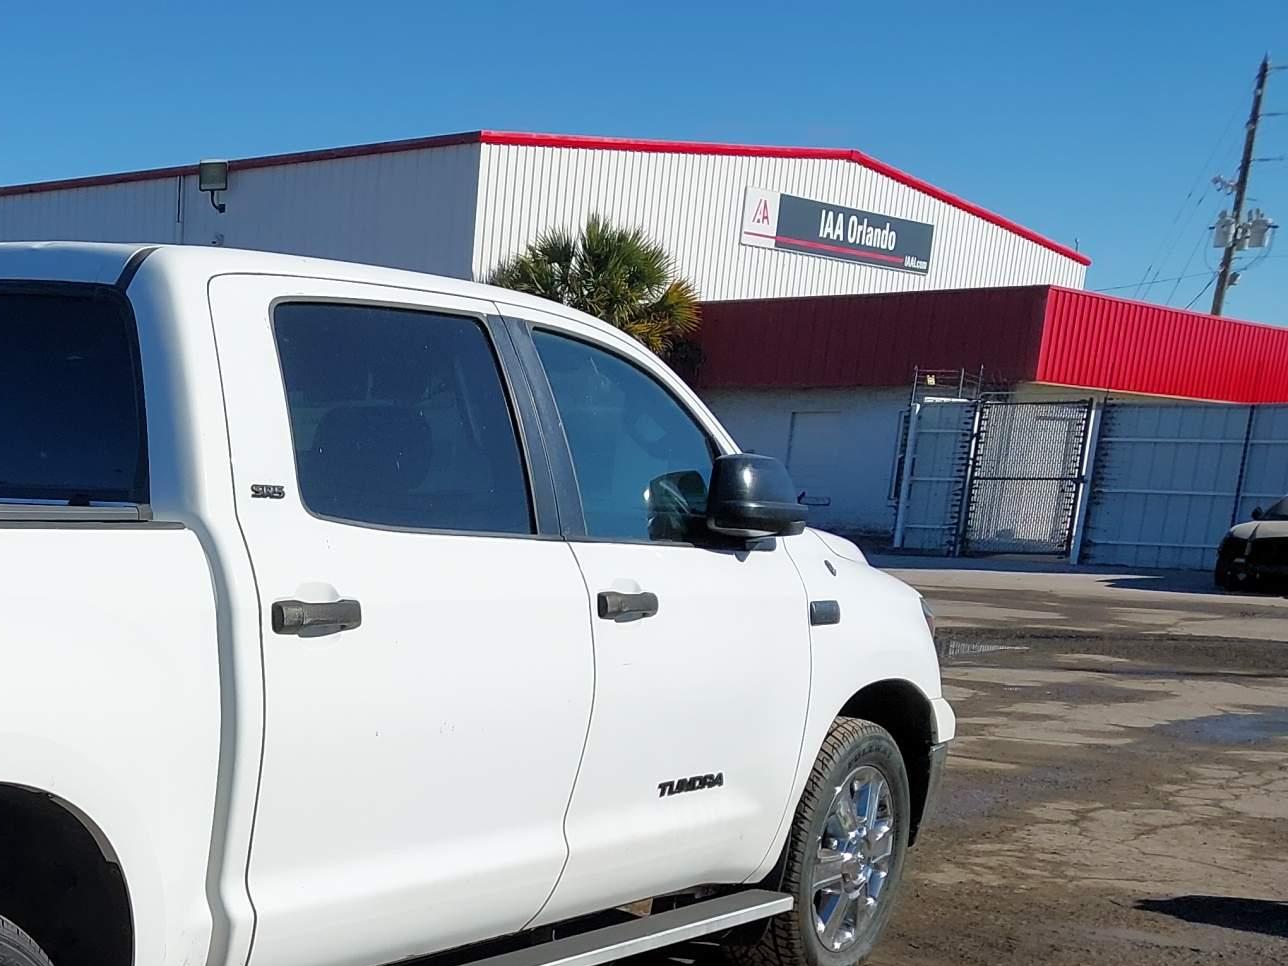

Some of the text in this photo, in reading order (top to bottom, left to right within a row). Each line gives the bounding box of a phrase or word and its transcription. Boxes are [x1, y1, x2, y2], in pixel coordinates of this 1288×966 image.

[819, 209, 897, 251] IAA Orlando
[657, 772, 724, 798] TUNDRA
